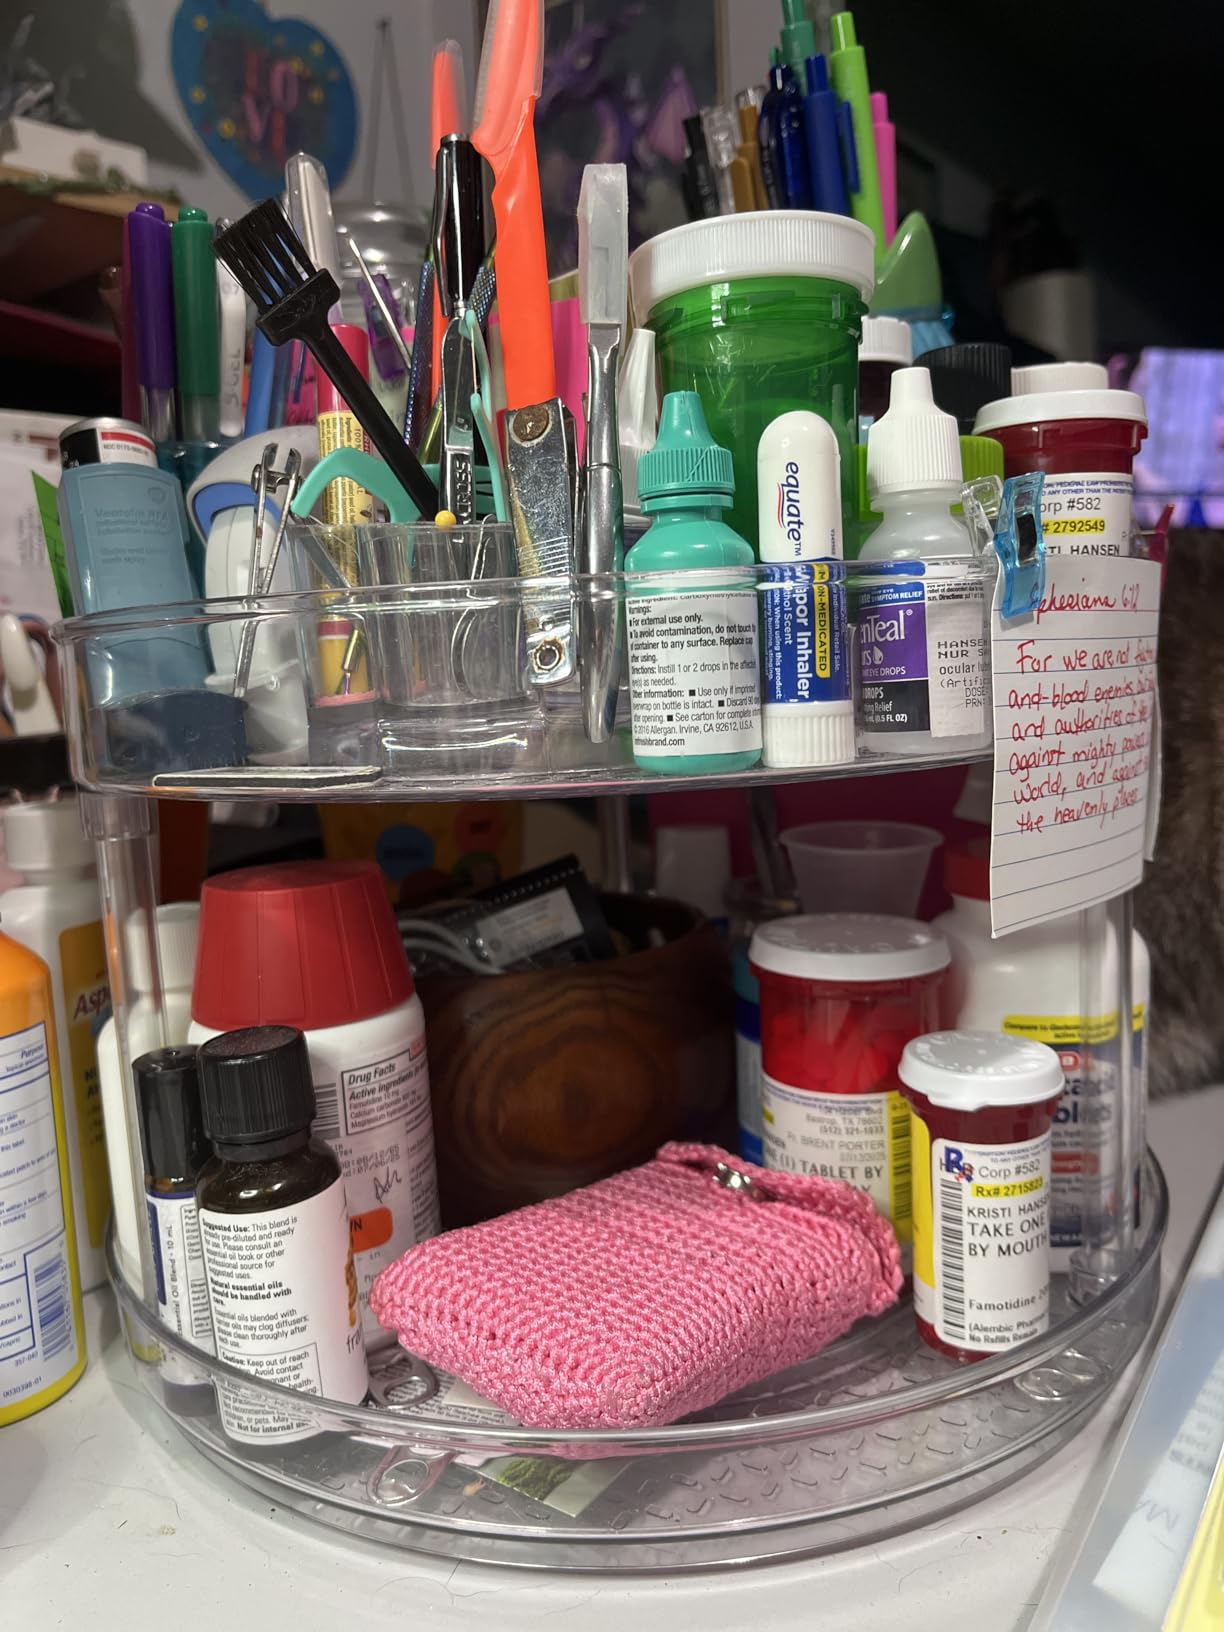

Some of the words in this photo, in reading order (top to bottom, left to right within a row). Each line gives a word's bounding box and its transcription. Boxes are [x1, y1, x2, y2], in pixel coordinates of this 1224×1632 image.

[1066, 497, 1101, 511] #582
[1052, 520, 1105, 534] 2792549
[1070, 545, 1120, 556] HANSEN
[900, 590, 922, 599] RELIEF
[641, 615, 666, 626] external
[668, 615, 683, 624] use
[684, 613, 703, 623] only.
[774, 606, 782, 628] When
[639, 628, 654, 638] avoid
[656, 625, 714, 637] contamination,
[715, 624, 725, 633] do
[726, 623, 737, 633] not
[783, 610, 793, 645] Scent
[817, 586, 827, 672] ON-MEDICATED
[661, 640, 668, 649] to
[670, 640, 684, 650] any
[686, 637, 718, 649] surface.
[720, 636, 744, 648] Replace
[774, 629, 783, 651] using
[640, 653, 658, 664] using.
[938, 650, 968, 660] NUR
[1016, 639, 1053, 674] For
[1063, 648, 1088, 671] we
[1092, 650, 1113, 670] are
[658, 664, 675, 674] Instill
[683, 665, 691, 673] or
[692, 663, 698, 672] 2
[700, 662, 721, 675] drops
[722, 661, 728, 670] in
[729, 660, 739, 670] the
[797, 631, 813, 700] Inhaler
[880, 666, 906, 676] DROPS
[939, 662, 976, 675] ocular
[650, 677, 676, 686] needed.
[643, 688, 685, 698] information:
[698, 687, 711, 697] Use
[714, 686, 728, 697] only
[729, 686, 735, 694] if
[653, 702, 660, 710] on
[662, 700, 682, 710] bottle
[684, 701, 690, 710] is
[691, 700, 714, 709] intact.
[727, 697, 747, 707] Discard
[875, 701, 893, 714] Relief
[675, 712, 690, 722] See
[691, 711, 714, 721] carton
[716, 710, 726, 720] for
[727, 708, 751, 720] complete
[886, 714, 894, 722] FL
[895, 713, 908, 723] OZ)
[679, 724, 702, 735] Irvine,
[703, 723, 714, 733] CA
[715, 721, 739, 733] 92612,
[1012, 716, 1045, 742] and
[1055, 703, 1122, 736] authorities
[1009, 741, 1066, 782] against
[1072, 734, 1117, 769] mighty
[1076, 761, 1106, 788] and
[1016, 811, 1044, 833] the
[1054, 791, 1109, 829] heavenly
[348, 1072, 371, 1086] Drug
[373, 1062, 396, 1079] Facts
[349, 1086, 376, 1101] Active
[800, 1136, 835, 1149] BRENT
[838, 1140, 885, 1151] PORTER
[799, 1159, 858, 1179] TABLET
[864, 1165, 884, 1179] BY
[978, 1165, 1011, 1180] Corp
[1014, 1159, 1041, 1175] #582
[975, 1185, 1000, 1198] Rx#
[967, 1205, 1011, 1219] KRISTI
[252, 1223, 267, 1232] This
[269, 1218, 289, 1229] blend
[291, 1216, 298, 1224] is
[967, 1220, 1014, 1238] TAKE
[1019, 1213, 1046, 1235] ONE
[221, 1233, 256, 1242] pre-diluted
[258, 1231, 272, 1240] and
[274, 1227, 294, 1239] ready
[166, 1240, 174, 1250] 10
[223, 1241, 243, 1251] Please
[245, 1241, 271, 1251] consult
[273, 1240, 283, 1248] an
[968, 1243, 989, 1258] BY
[997, 1231, 1049, 1257] MOUTH
[238, 1252, 254, 1260] book
[265, 1249, 285, 1259] other
[169, 1258, 178, 1283] Blend
[240, 1261, 263, 1270] source
[264, 1259, 275, 1268] for
[235, 1271, 251, 1280] uses.
[231, 1281, 266, 1291] essential
[267, 1281, 283, 1289] oils
[231, 1292, 238, 1300] be
[240, 1290, 271, 1300] handled
[273, 1287, 292, 1298] with
[968, 1294, 1035, 1312] Famotidine
[238, 1312, 249, 1321] oils
[250, 1310, 280, 1322] blended
[281, 1308, 297, 1319] with
[231, 1321, 242, 1331] oils
[243, 1322, 257, 1333] may
[258, 1320, 274, 1332] clog
[233, 1331, 249, 1340] clean
[251, 1328, 288, 1342] thoroughly
[290, 1324, 307, 1336] after
[968, 1321, 1014, 1334] (Alembic
[969, 1333, 981, 1343] No
[983, 1334, 1011, 1344] Refills
[247, 1358, 265, 1369] Keep
[266, 1357, 278, 1367] out
[279, 1355, 288, 1365] of
[289, 1351, 309, 1363] reach
[254, 1366, 274, 1376] Avoid
[276, 1362, 303, 1374] contact
[293, 1373, 300, 1381] or
[237, 1422, 248, 1431] Not
[250, 1425, 260, 1433] for
[262, 1421, 294, 1433] internal
